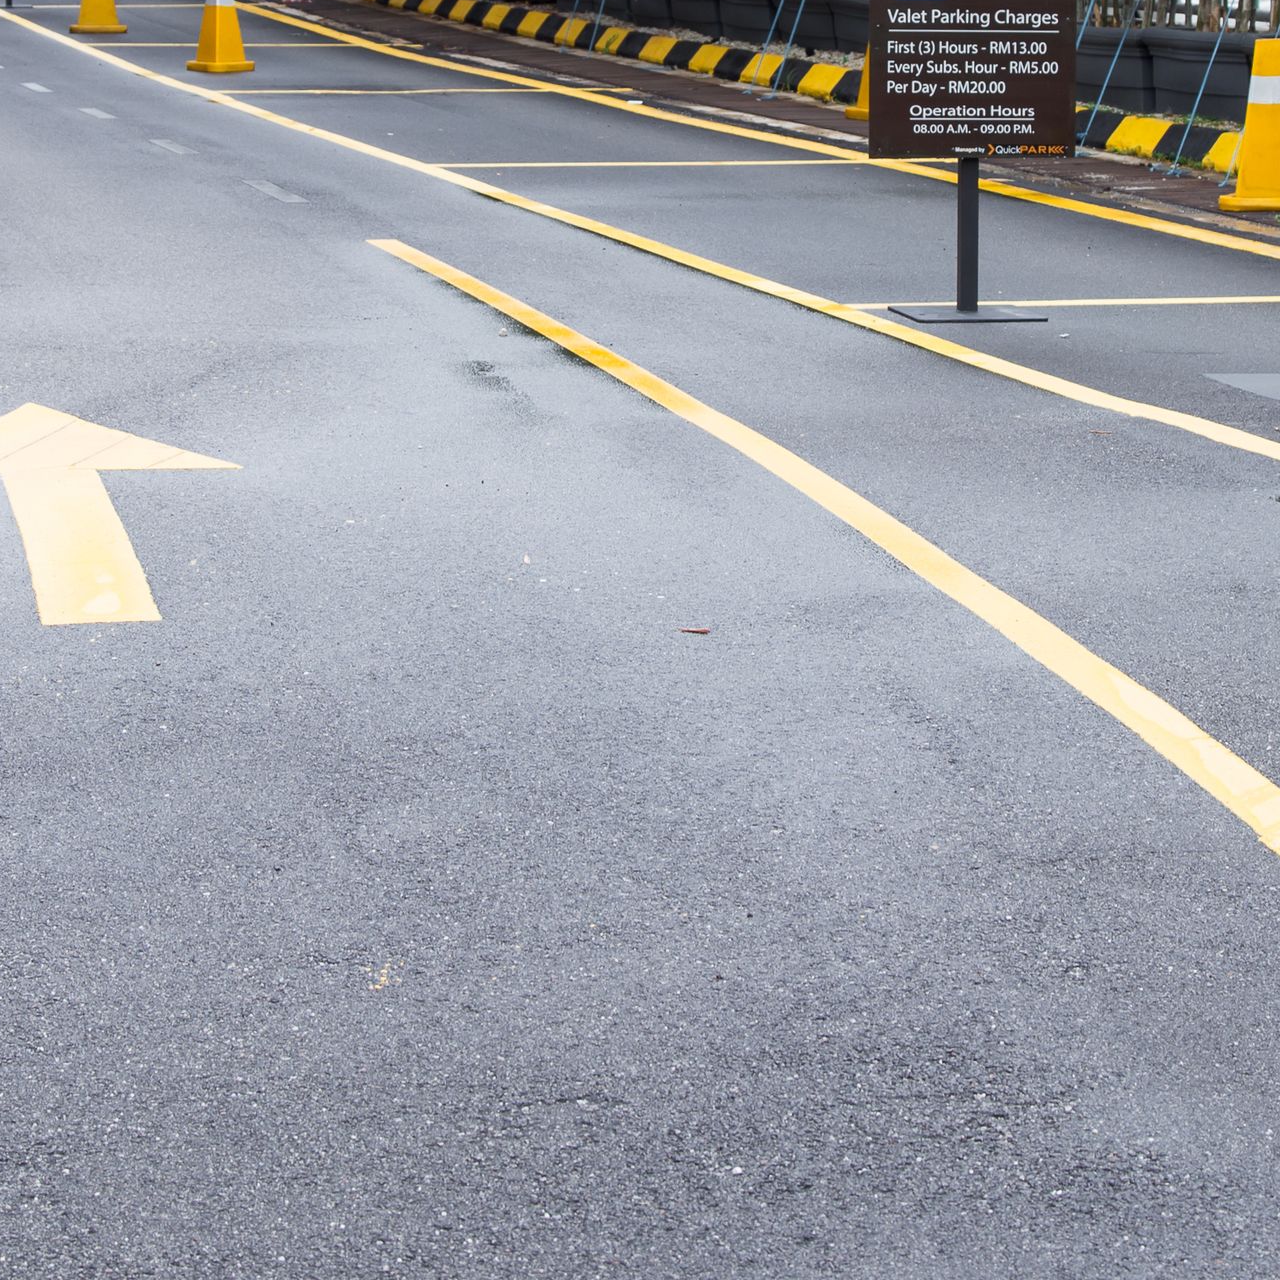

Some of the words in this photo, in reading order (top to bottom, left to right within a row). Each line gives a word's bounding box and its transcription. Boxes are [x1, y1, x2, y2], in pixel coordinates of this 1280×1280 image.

[887, 8, 928, 24] Valet
[931, 8, 991, 28] Parking
[994, 8, 1059, 28] Charges
[887, 40, 916, 54] First
[918, 40, 936, 56] (3)
[938, 40, 979, 55] Hours
[989, 40, 1048, 55] RM13.00
[887, 60, 924, 77] Every
[926, 60, 962, 74] Subs.
[964, 60, 999, 74] Hour
[1009, 60, 1059, 75] RM5.00
[886, 80, 909, 94] Per
[911, 80, 938, 97] Day
[948, 80, 1006, 94] RM20.00
[909, 104, 986, 120] Operation
[990, 104, 1035, 117] Hours
[913, 123, 945, 134] 08.00
[946, 123, 971, 134] A.M.
[980, 123, 1011, 134] 09.00
[1013, 123, 1035, 134] P.M.
